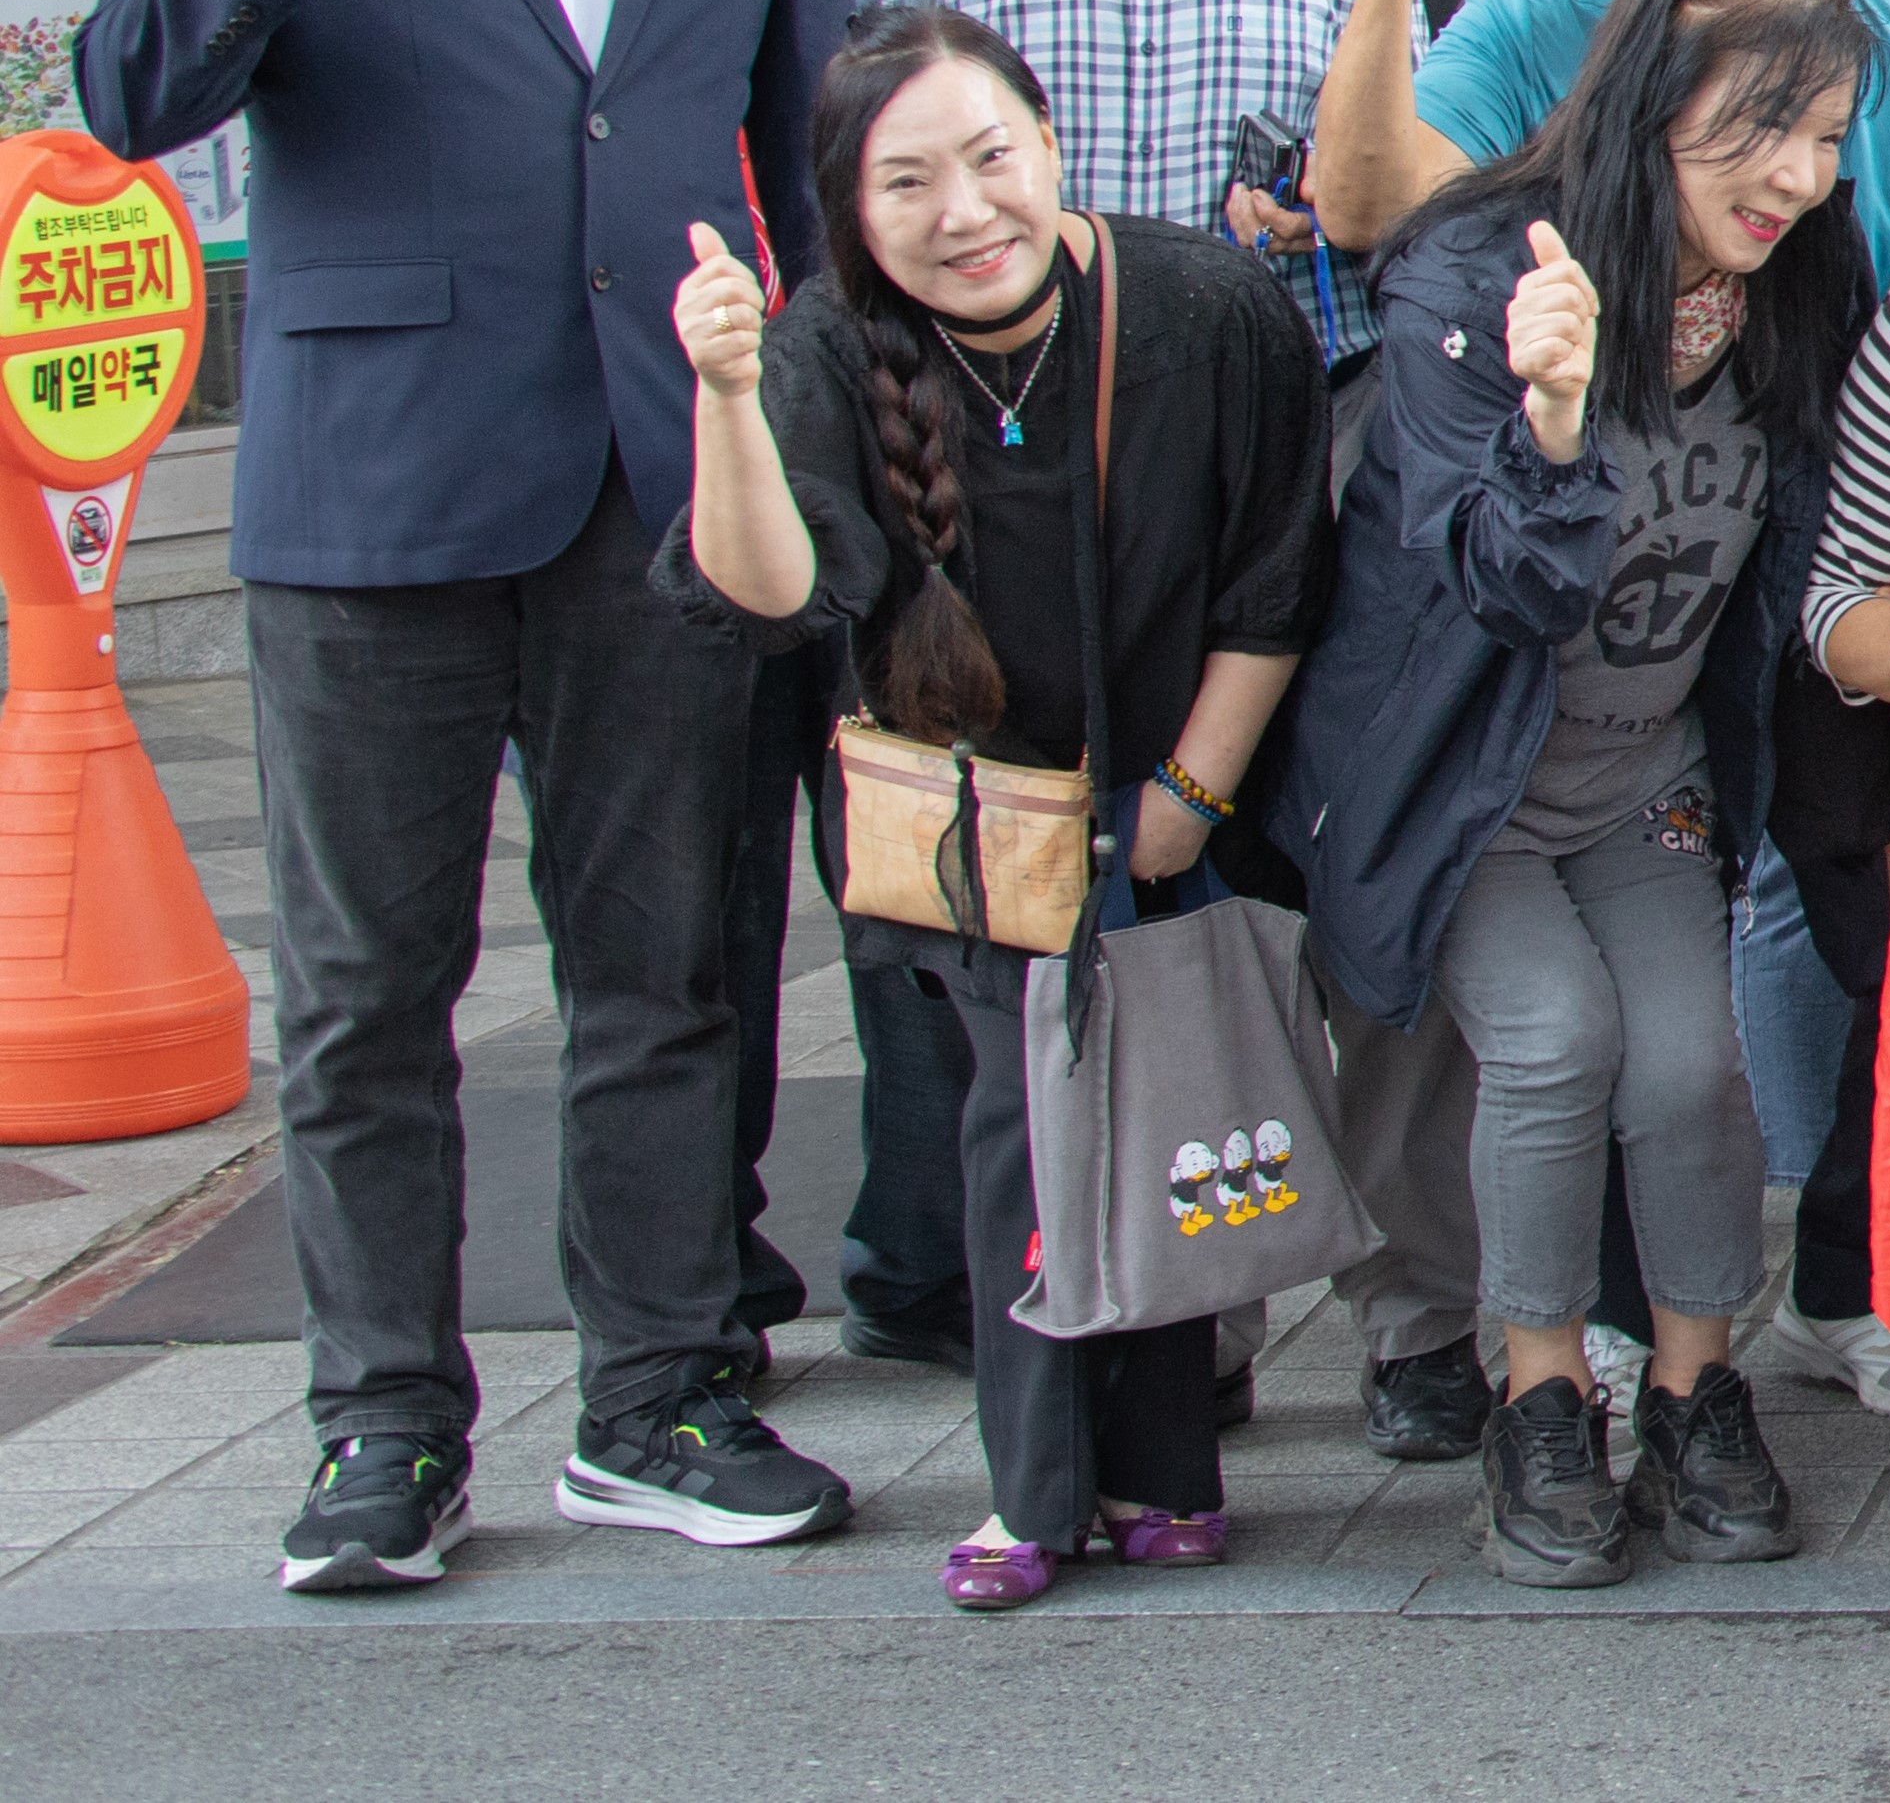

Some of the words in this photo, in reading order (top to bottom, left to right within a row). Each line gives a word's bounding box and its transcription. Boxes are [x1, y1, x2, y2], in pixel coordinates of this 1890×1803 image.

[34, 205, 148, 240] 협조부탁드립니다
[17, 234, 174, 320] 주차금지
[33, 344, 162, 413] 매일약국
[1602, 574, 1714, 650] 37
